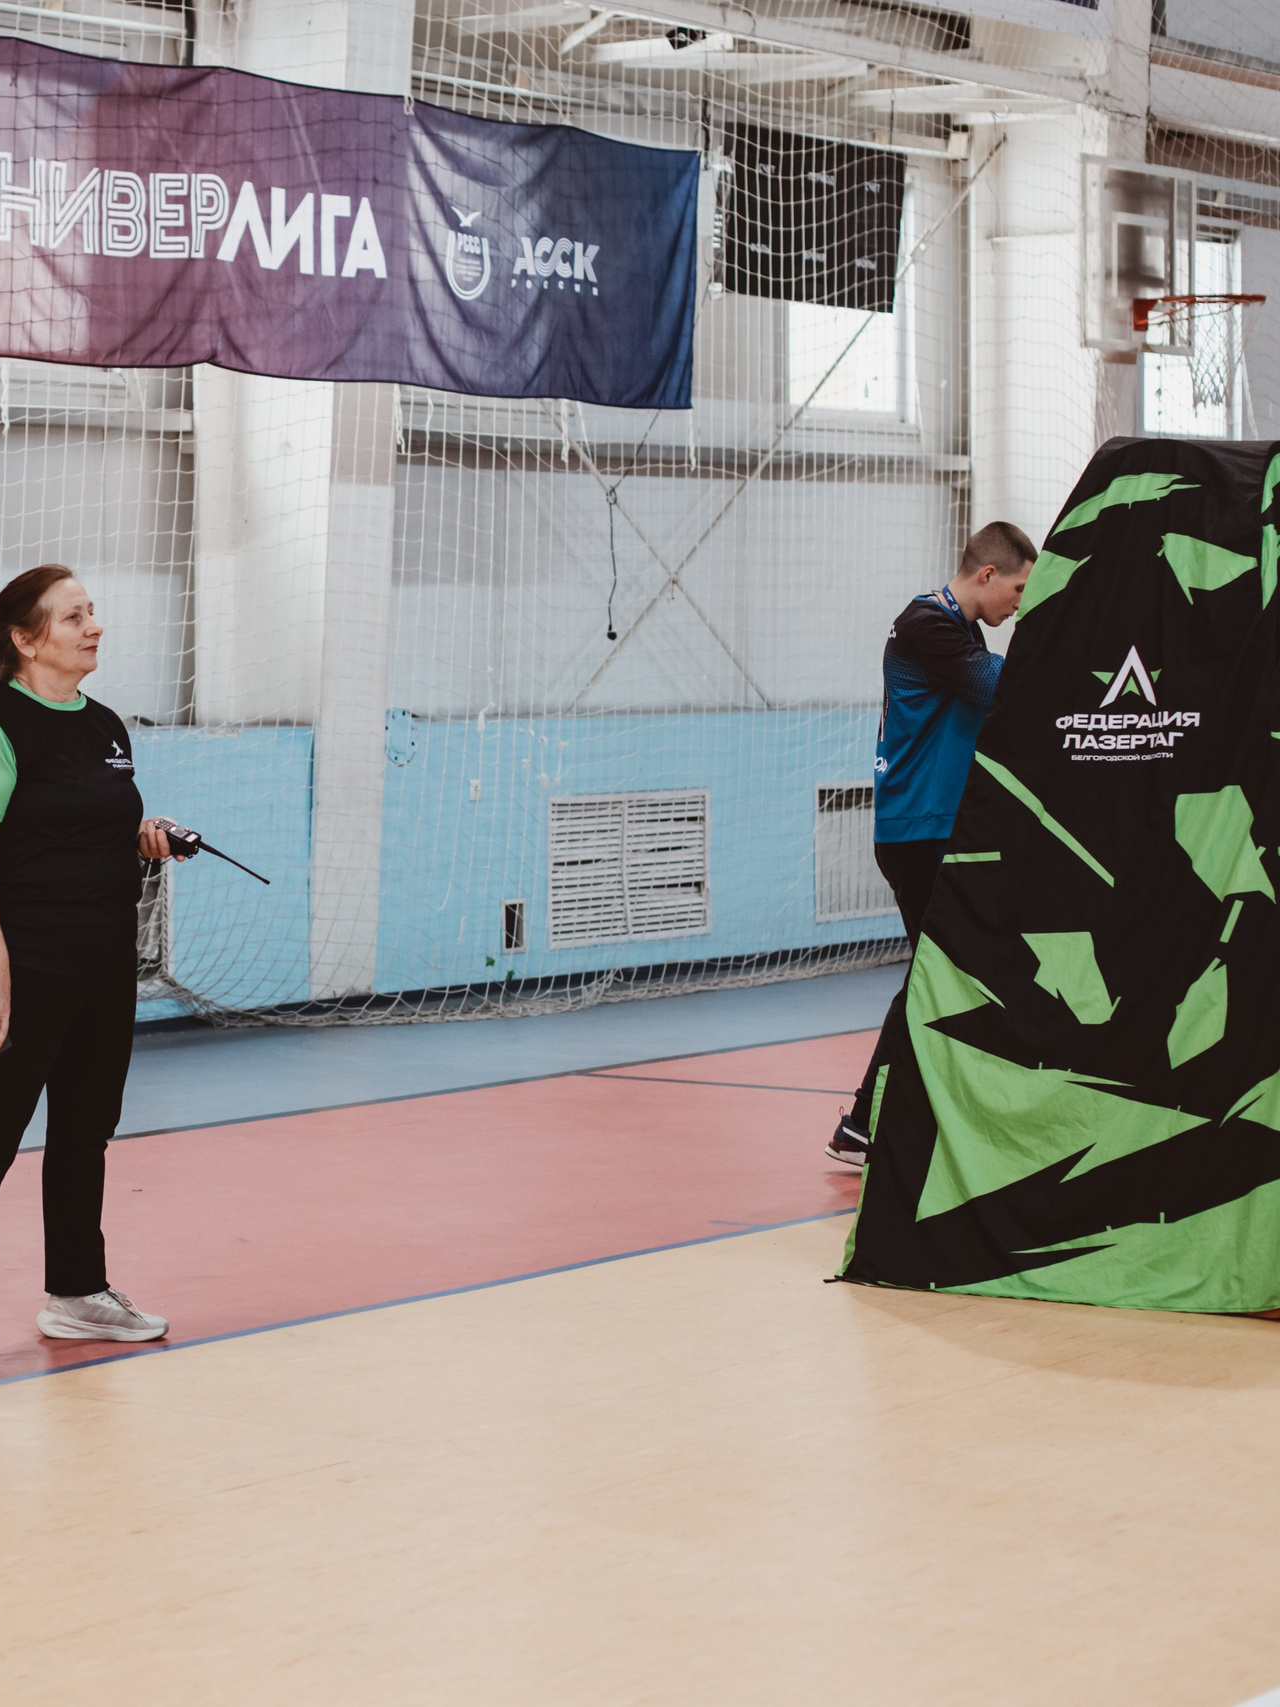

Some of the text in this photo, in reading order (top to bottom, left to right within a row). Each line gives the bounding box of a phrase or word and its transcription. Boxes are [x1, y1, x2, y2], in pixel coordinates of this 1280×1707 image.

[512, 236, 600, 283] АССК
[1055, 711, 1201, 731] ФЕДЕРАЦИЯ
[1062, 732, 1184, 750] ЛАЗЕРТАГ
[1071, 754, 1140, 762] БЕЛГОРОДСКОЙ
